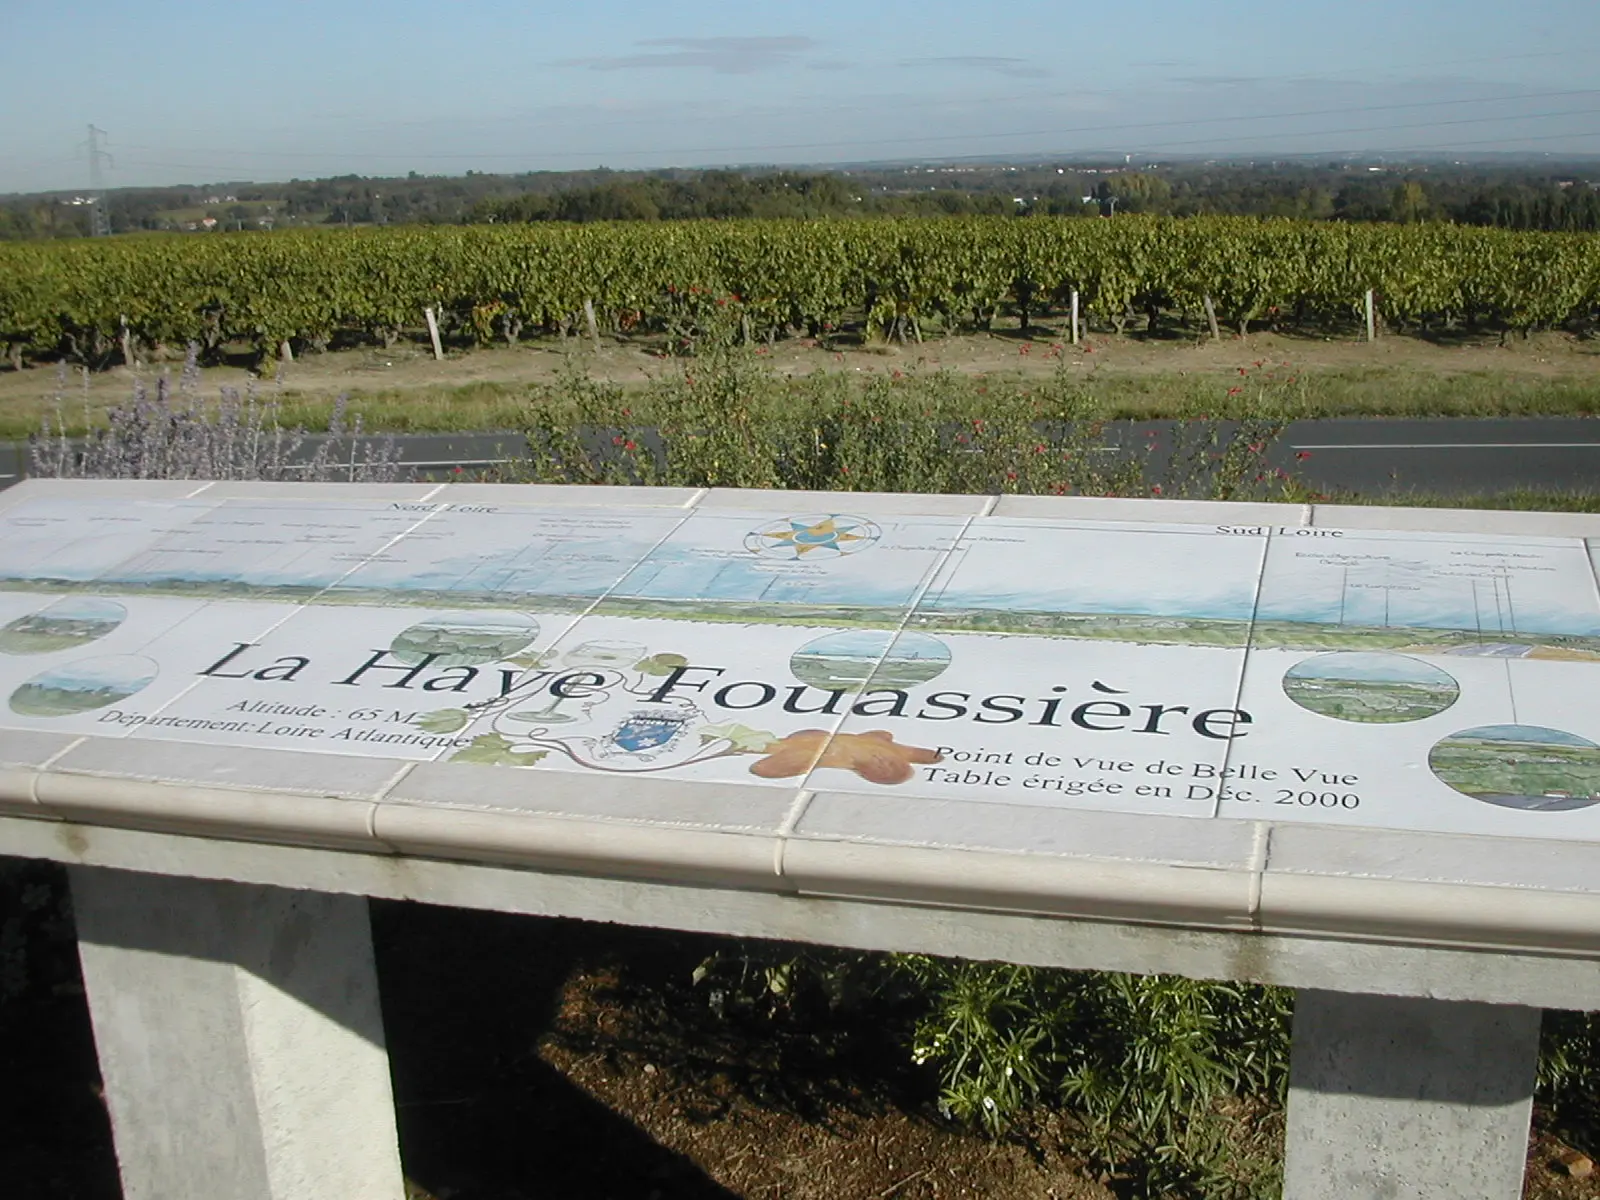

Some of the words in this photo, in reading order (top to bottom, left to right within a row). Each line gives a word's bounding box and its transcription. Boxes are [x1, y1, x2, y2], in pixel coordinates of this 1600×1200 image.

[386, 503, 438, 512] Nord
[445, 504, 499, 513] Loire
[1216, 525, 1262, 535] Sud
[1279, 527, 1343, 538] Loire
[196, 642, 310, 683] La
[330, 649, 606, 709] Haye
[637, 665, 1253, 740] Fouassière
[226, 699, 327, 718] Altitude
[347, 708, 384, 721] 65
[255, 721, 325, 738] Loire
[331, 727, 471, 749] Atlantique
[933, 746, 1013, 765] Point
[1024, 751, 1062, 767] de
[1146, 760, 1184, 776] de
[1192, 763, 1278, 781] Belle
[1291, 768, 1359, 786] Vue
[922, 768, 1011, 787] Table
[1022, 774, 1124, 796] érigée
[1135, 784, 1172, 798] en
[1187, 784, 1261, 802] Déc.
[1274, 789, 1361, 810] 2000
